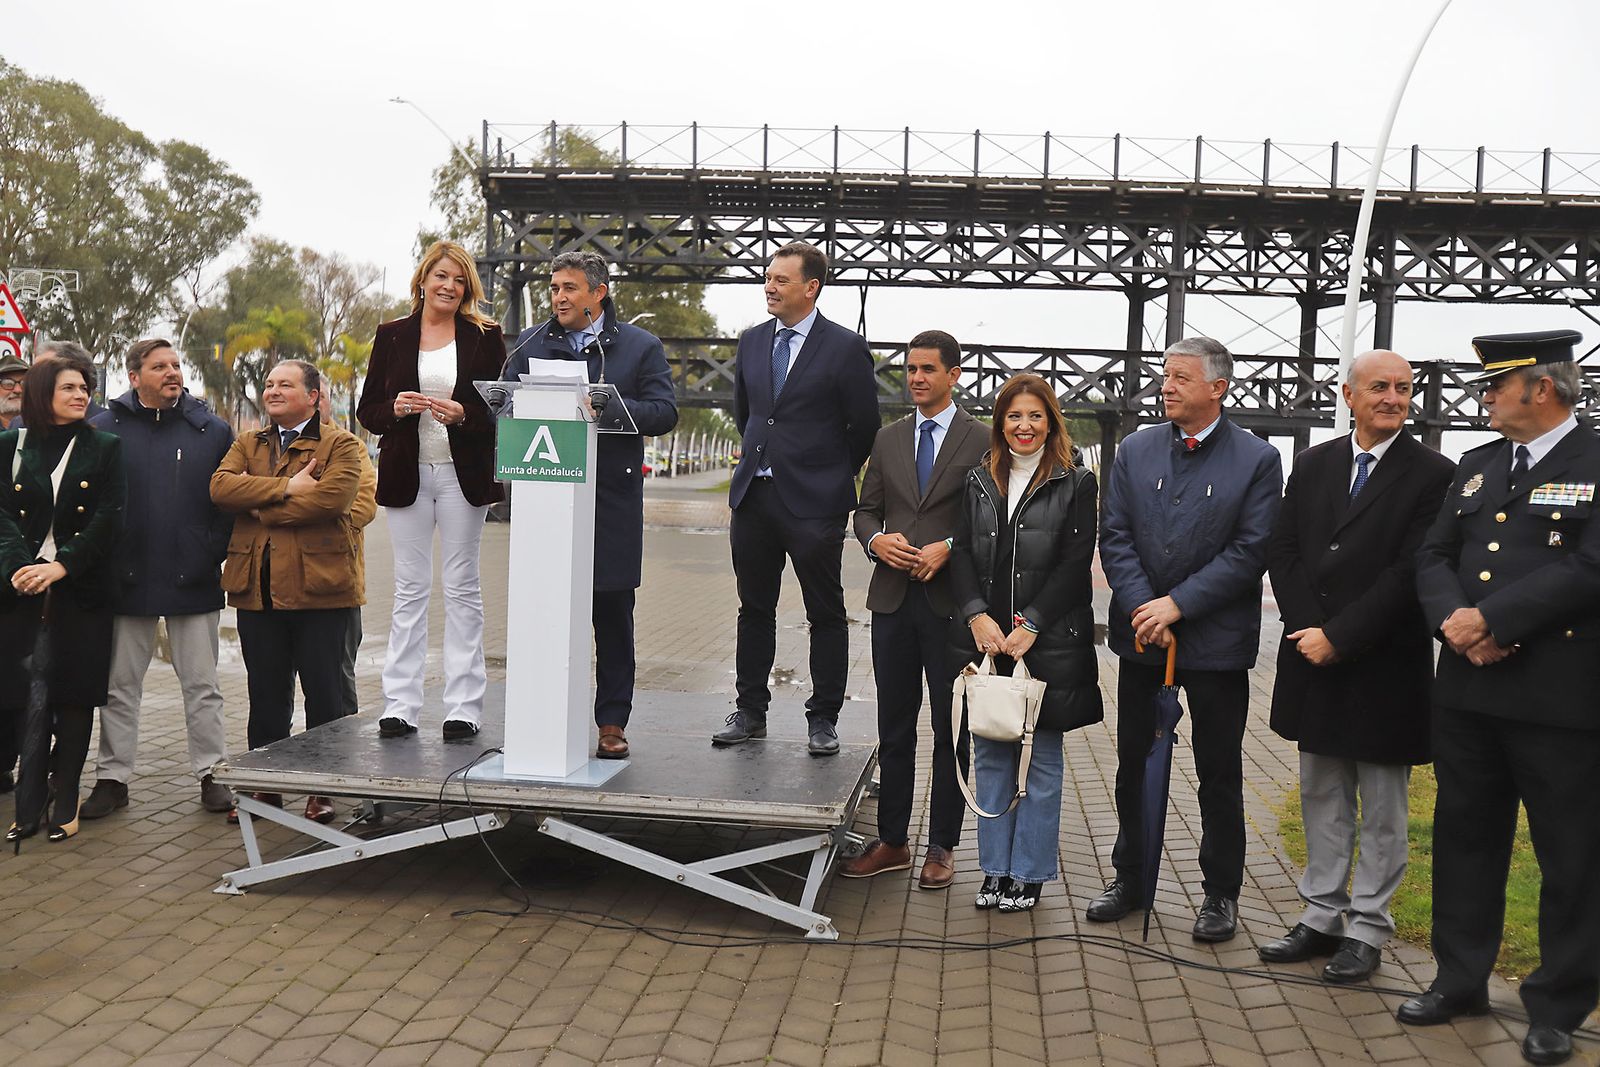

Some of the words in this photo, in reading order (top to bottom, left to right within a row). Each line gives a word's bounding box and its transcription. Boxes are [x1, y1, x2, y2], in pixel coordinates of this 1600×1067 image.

[499, 465, 525, 475] Junta
[526, 466, 538, 475] de
[539, 467, 583, 477] Andalucía
